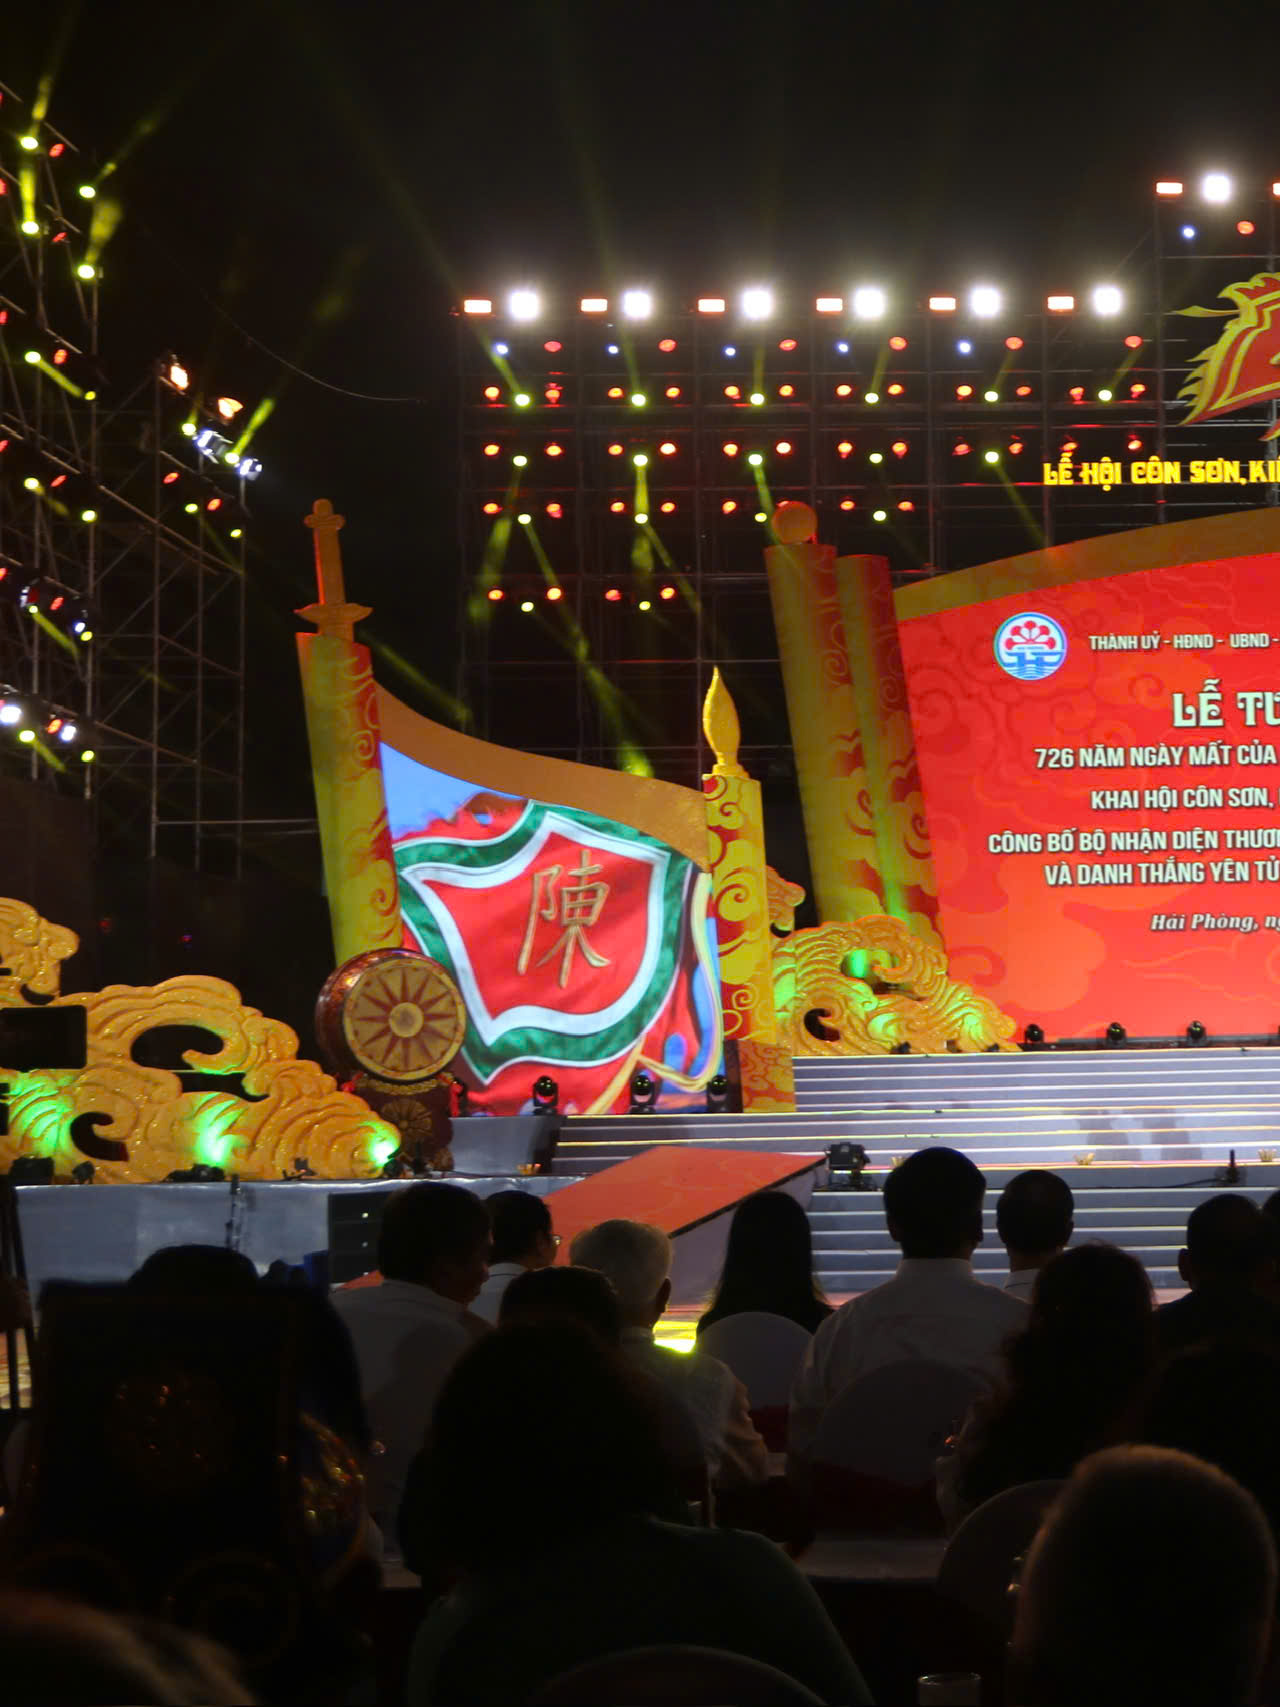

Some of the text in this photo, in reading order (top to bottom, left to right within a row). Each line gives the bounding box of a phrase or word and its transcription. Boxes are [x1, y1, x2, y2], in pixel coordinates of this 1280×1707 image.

[1043, 452, 1073, 485] LỄ
[1079, 456, 1122, 491] HỘI
[1131, 455, 1181, 485] CÔN
[1088, 633, 1138, 650] THÀNH
[1173, 634, 1214, 649] HĐND
[1229, 633, 1270, 648] UBND
[1172, 678, 1224, 727] LỄ
[1035, 748, 1074, 768] 726
[1079, 744, 1124, 767] NĂM
[1130, 743, 1184, 767] NGÀY
[1189, 741, 1232, 766] MẤT
[1237, 739, 1277, 765] CỦA
[1090, 790, 1139, 809] KHAI
[1144, 786, 1178, 812] HỘI
[1183, 785, 1223, 808] CÔN
[1228, 787, 1274, 808] SƠN,
[988, 830, 1042, 853] CÔNG
[1047, 827, 1077, 852] BỐ
[1080, 828, 1106, 855] BỘ
[1111, 828, 1167, 854] NHẬN
[1172, 827, 1218, 853] DIỆN
[1044, 861, 1072, 885] VÀ
[1077, 864, 1132, 884] DANH
[1137, 855, 1204, 883] THẮNG
[1209, 858, 1249, 882] YÊN
[1254, 855, 1279, 882] TỬ
[517, 849, 611, 989] 陳
[1151, 913, 1185, 930] Hải
[1191, 913, 1258, 932] Phòng,
